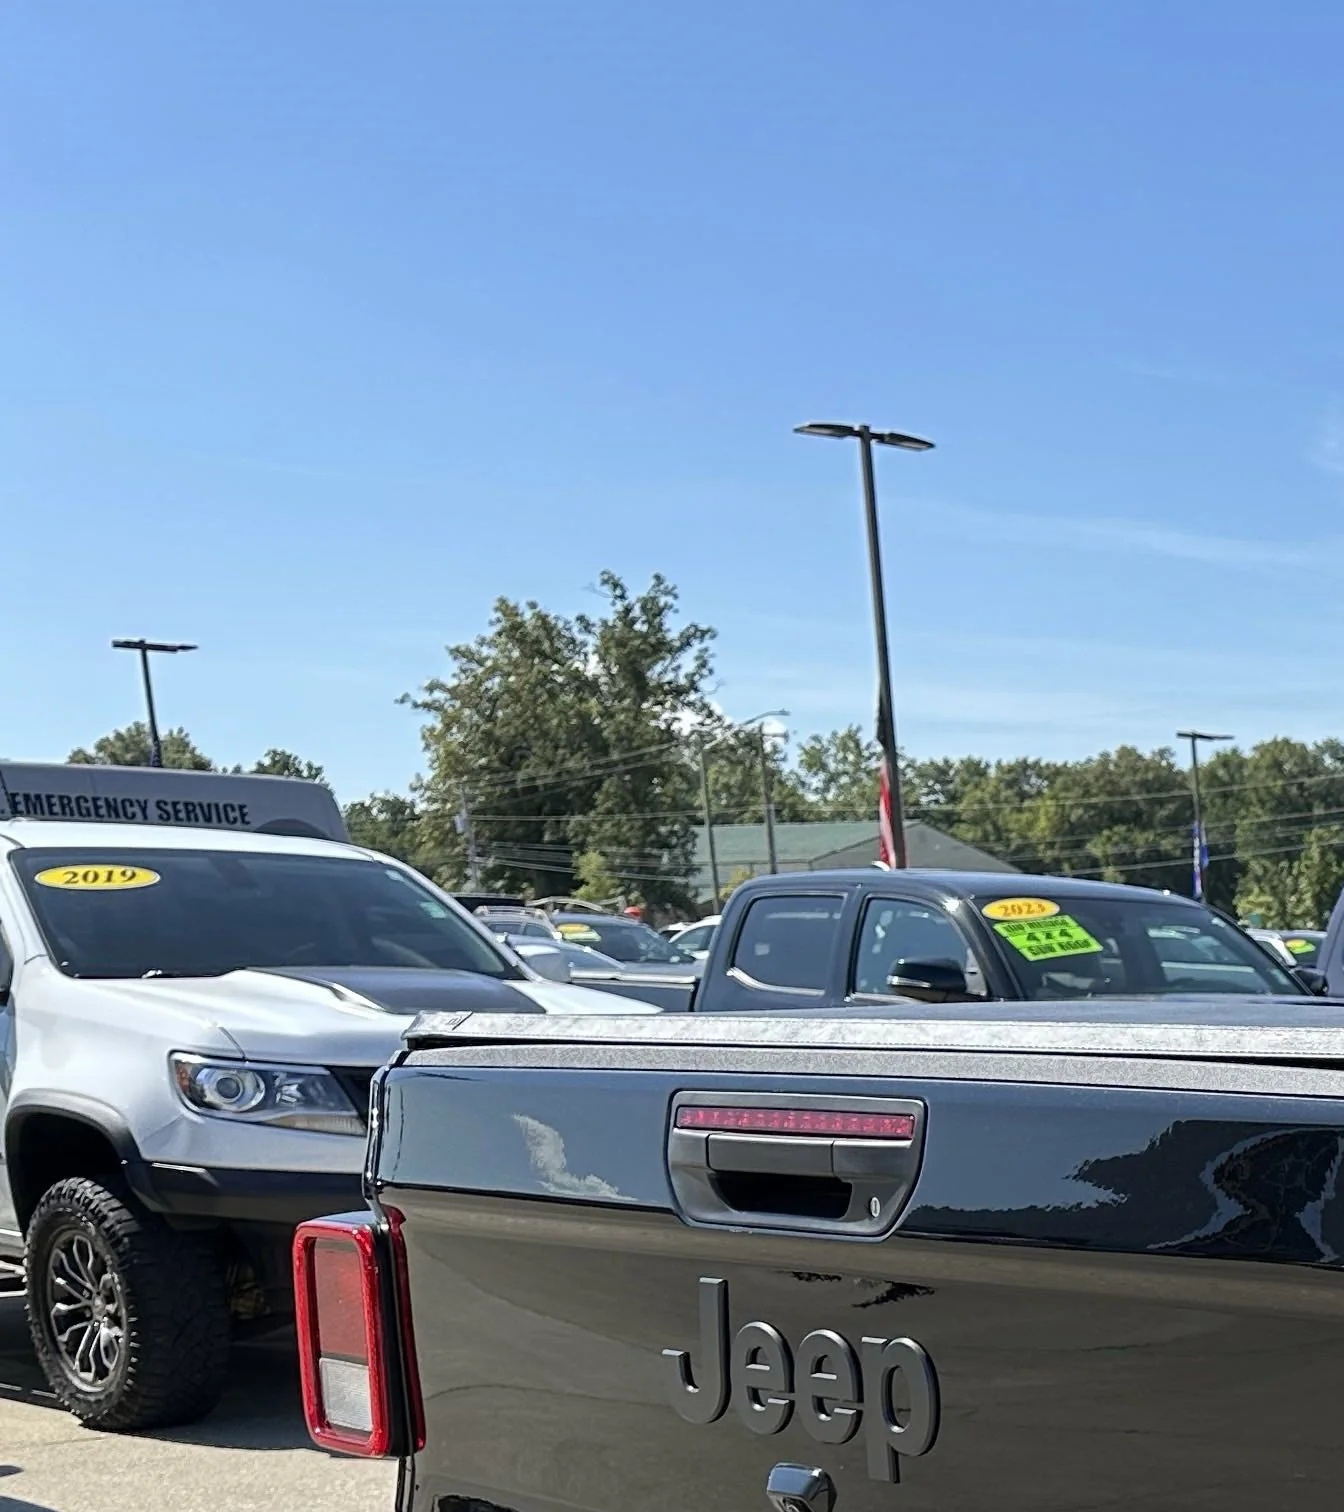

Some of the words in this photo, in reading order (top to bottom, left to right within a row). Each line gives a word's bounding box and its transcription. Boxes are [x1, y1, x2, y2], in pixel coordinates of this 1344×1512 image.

[9, 792, 150, 821] EMERGENCY
[156, 799, 251, 825] SERVICE
[62, 868, 137, 885] 2019
[661, 1275, 941, 1485] Jeep
